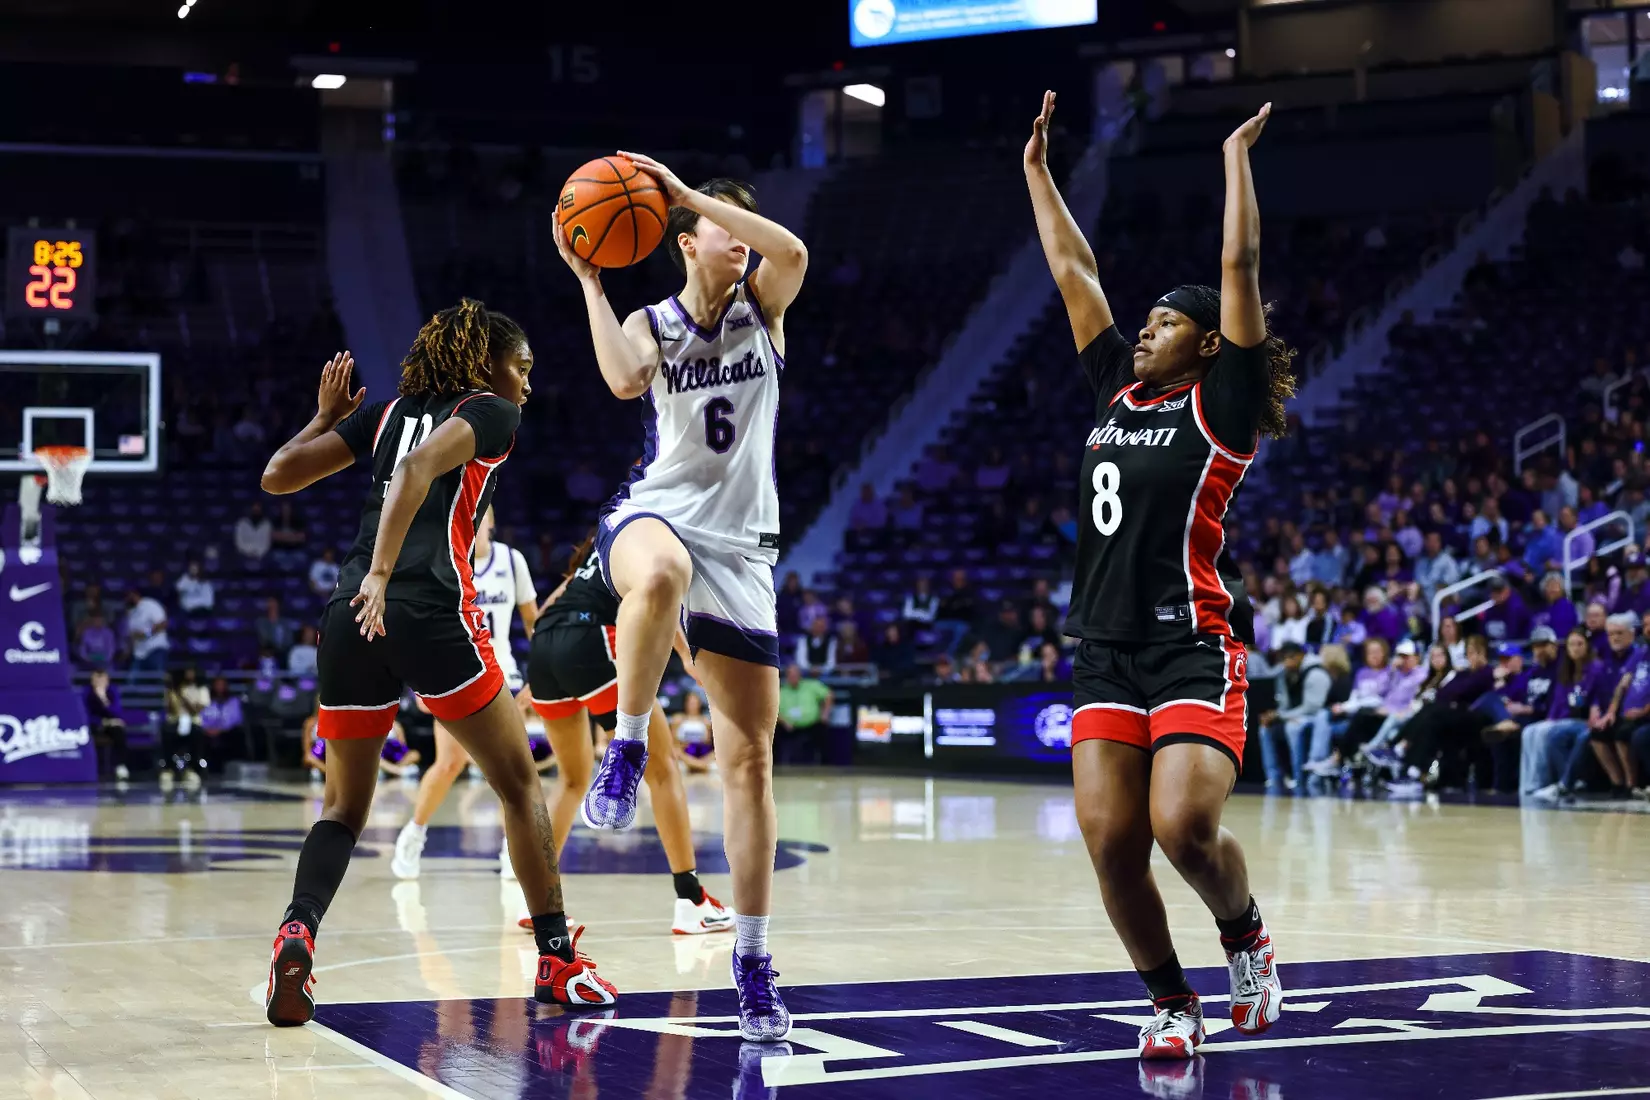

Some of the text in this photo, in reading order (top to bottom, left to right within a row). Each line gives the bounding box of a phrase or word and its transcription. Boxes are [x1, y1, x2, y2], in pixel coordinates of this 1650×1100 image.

[547, 44, 600, 83] 15
[33, 240, 83, 267] 8:25
[26, 265, 76, 309] 22
[661, 349, 766, 395] Wildcats
[704, 396, 736, 455] 6
[1092, 461, 1123, 537] 8
